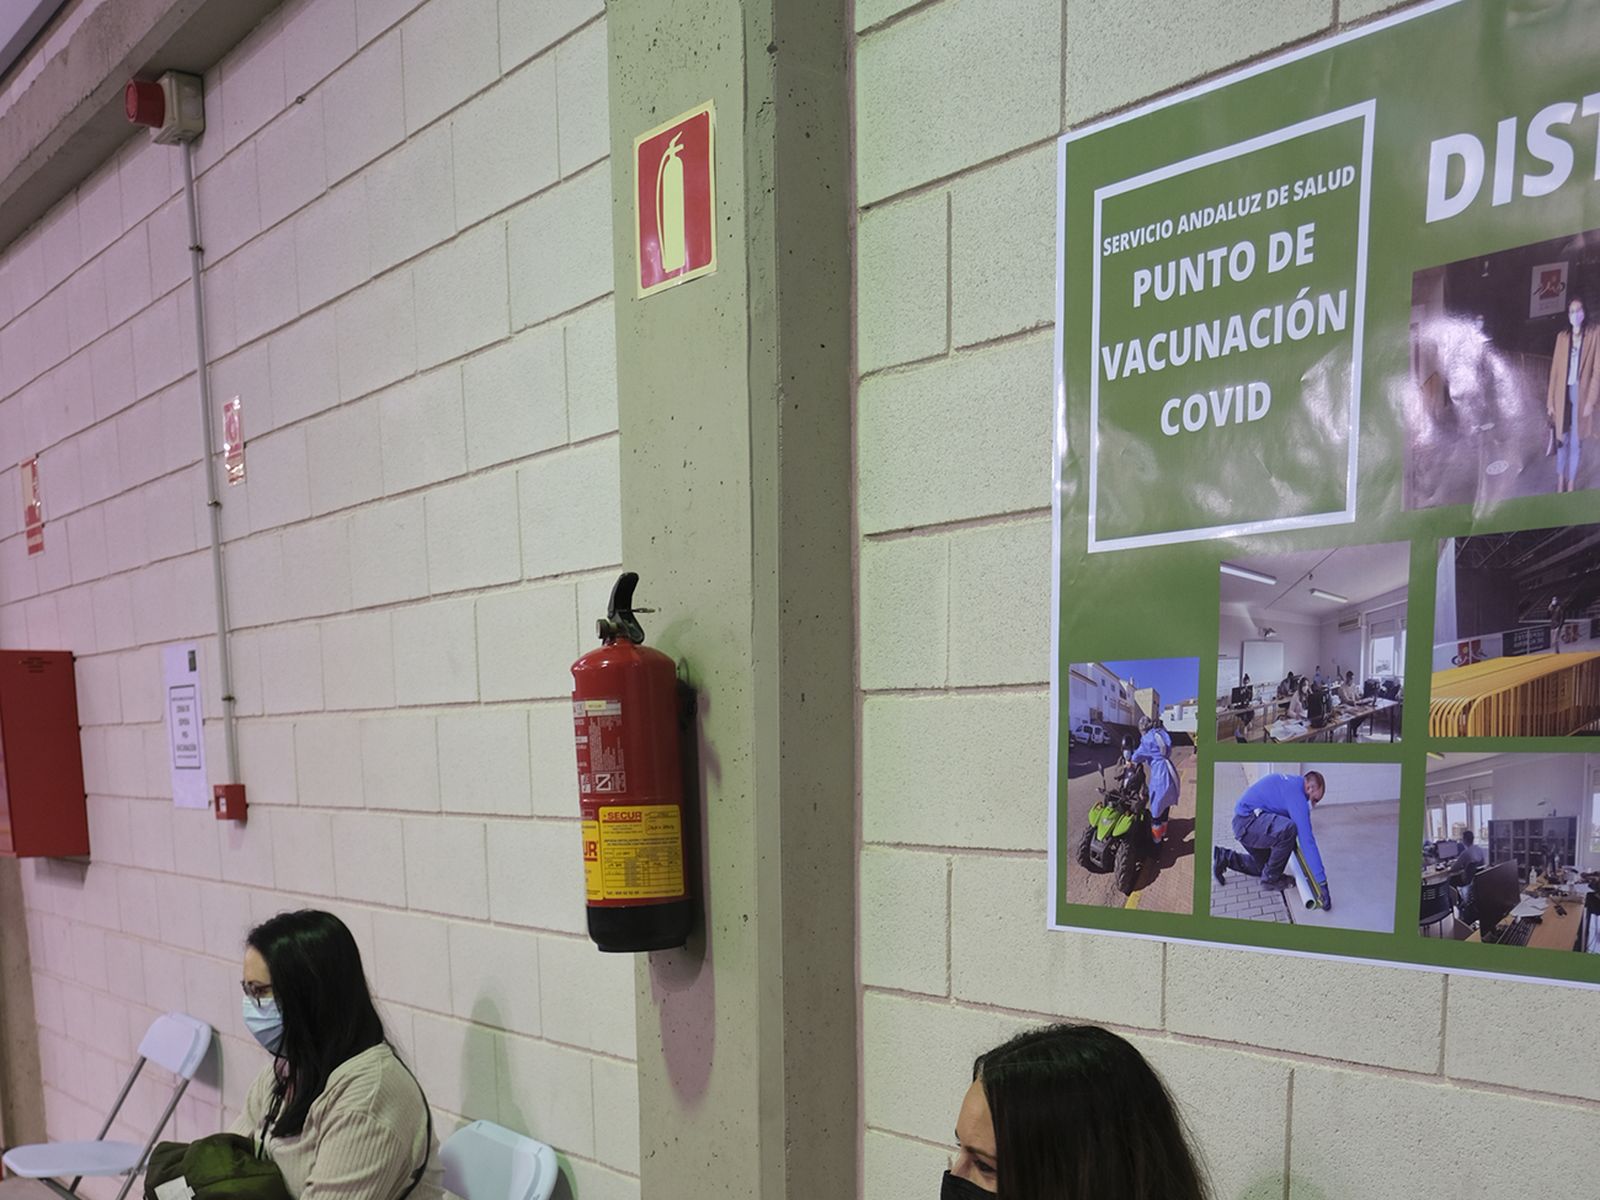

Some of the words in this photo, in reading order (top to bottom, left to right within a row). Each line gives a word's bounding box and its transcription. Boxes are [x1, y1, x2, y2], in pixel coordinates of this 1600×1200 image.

[1103, 219, 1173, 256] SERVICIO
[1177, 193, 1262, 236] ANDALUZ
[1266, 185, 1289, 210] DE
[1293, 165, 1356, 202] SALUD
[1133, 240, 1256, 308] PUNTO
[1268, 223, 1316, 273] DE
[1101, 286, 1348, 381] VACUNACIÓN
[1160, 381, 1272, 436] COVID
